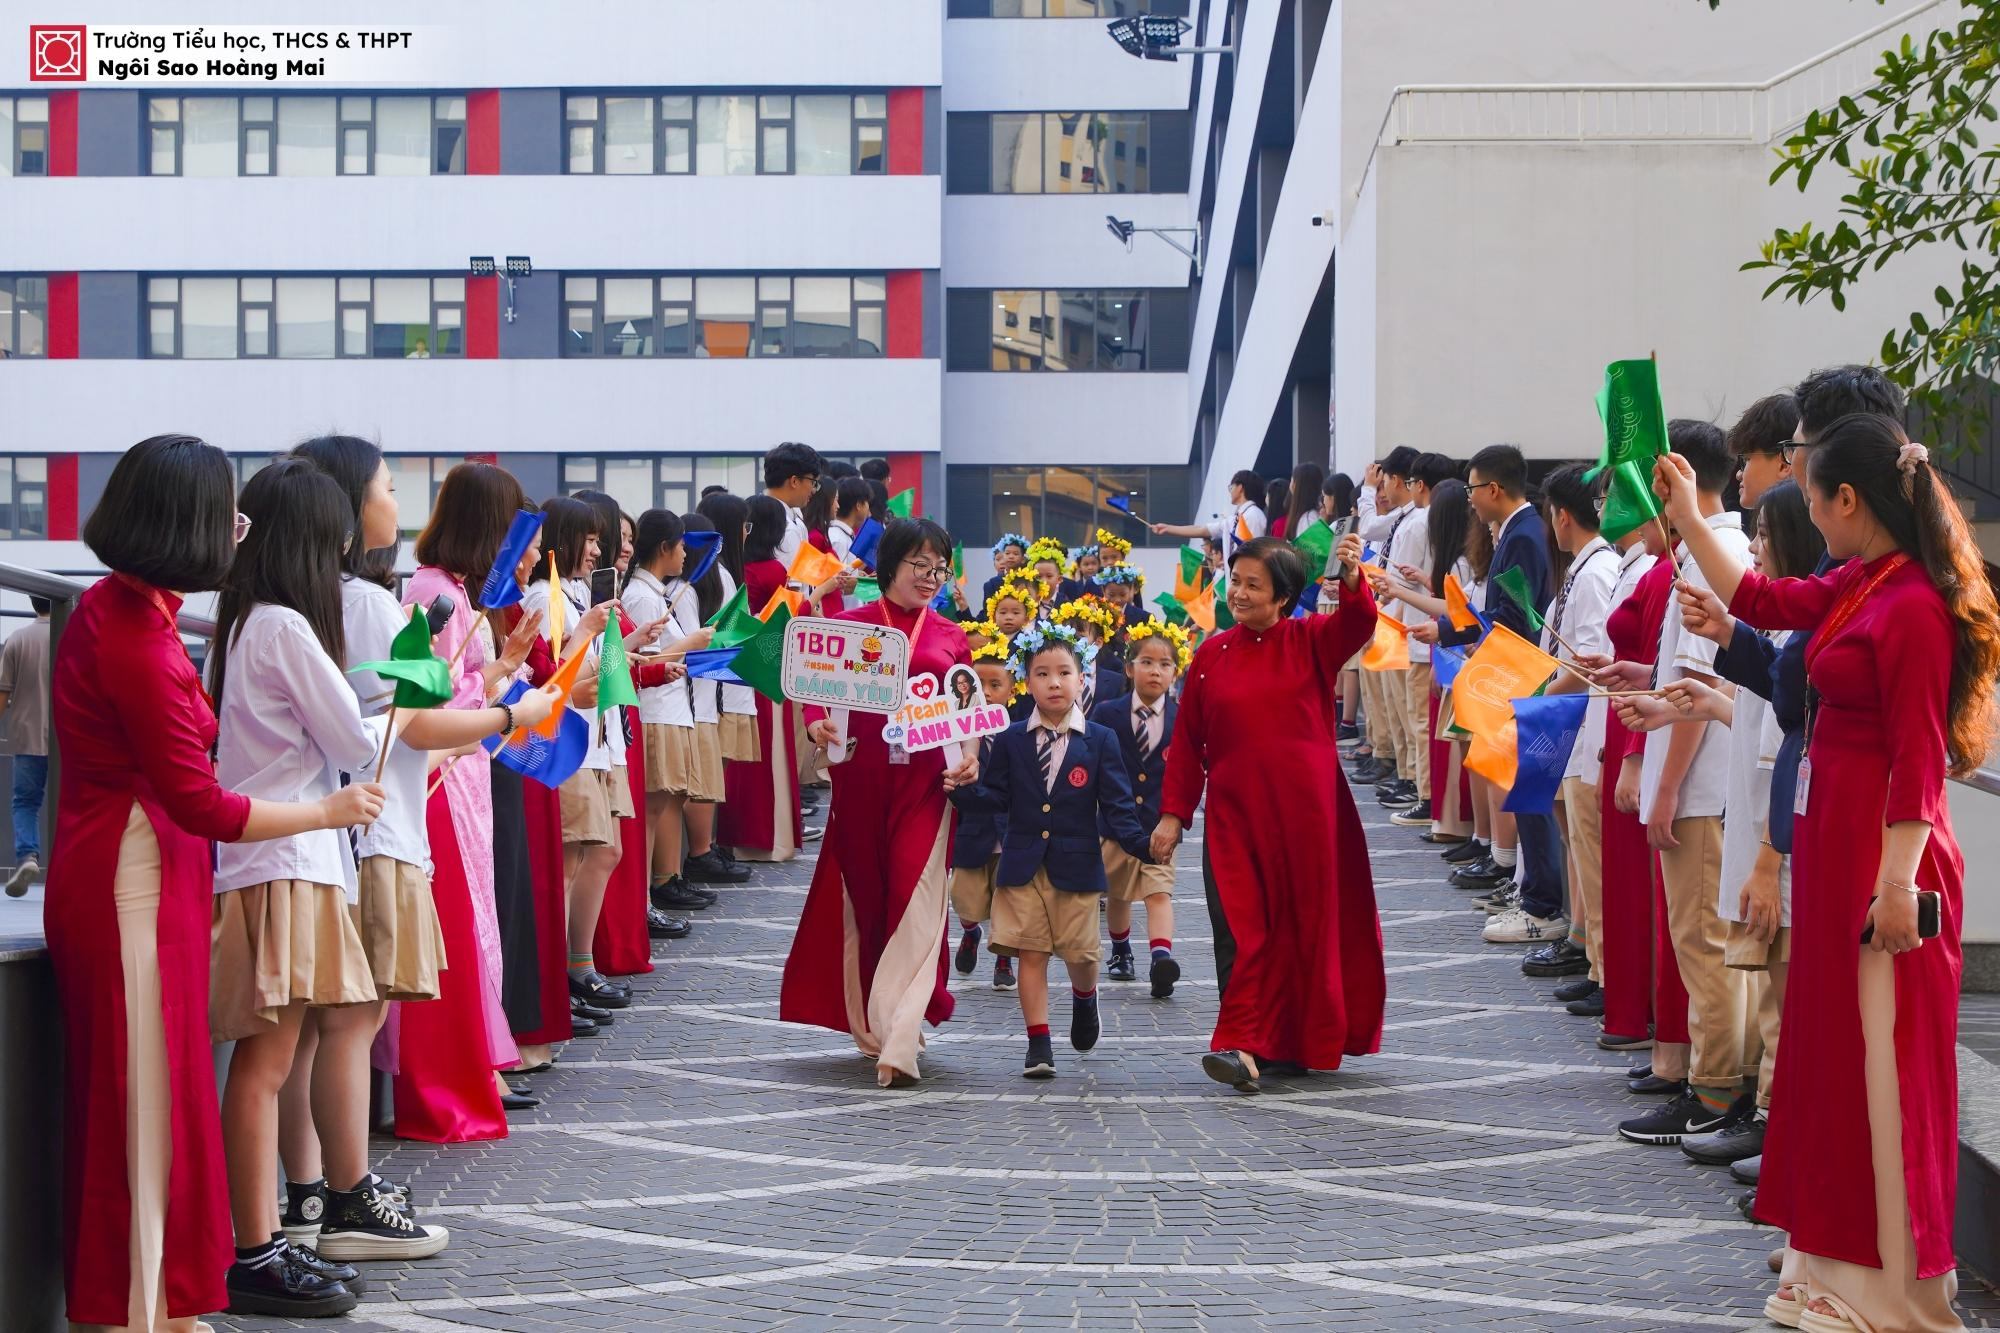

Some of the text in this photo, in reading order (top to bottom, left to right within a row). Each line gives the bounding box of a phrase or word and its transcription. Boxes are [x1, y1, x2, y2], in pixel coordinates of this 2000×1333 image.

[844, 660, 895, 676] Học giỏi
[854, 680, 893, 703] YÊU
[895, 700, 949, 724] #Team
[907, 721, 952, 748] ÁNH
[956, 707, 1005, 735] VÂN
